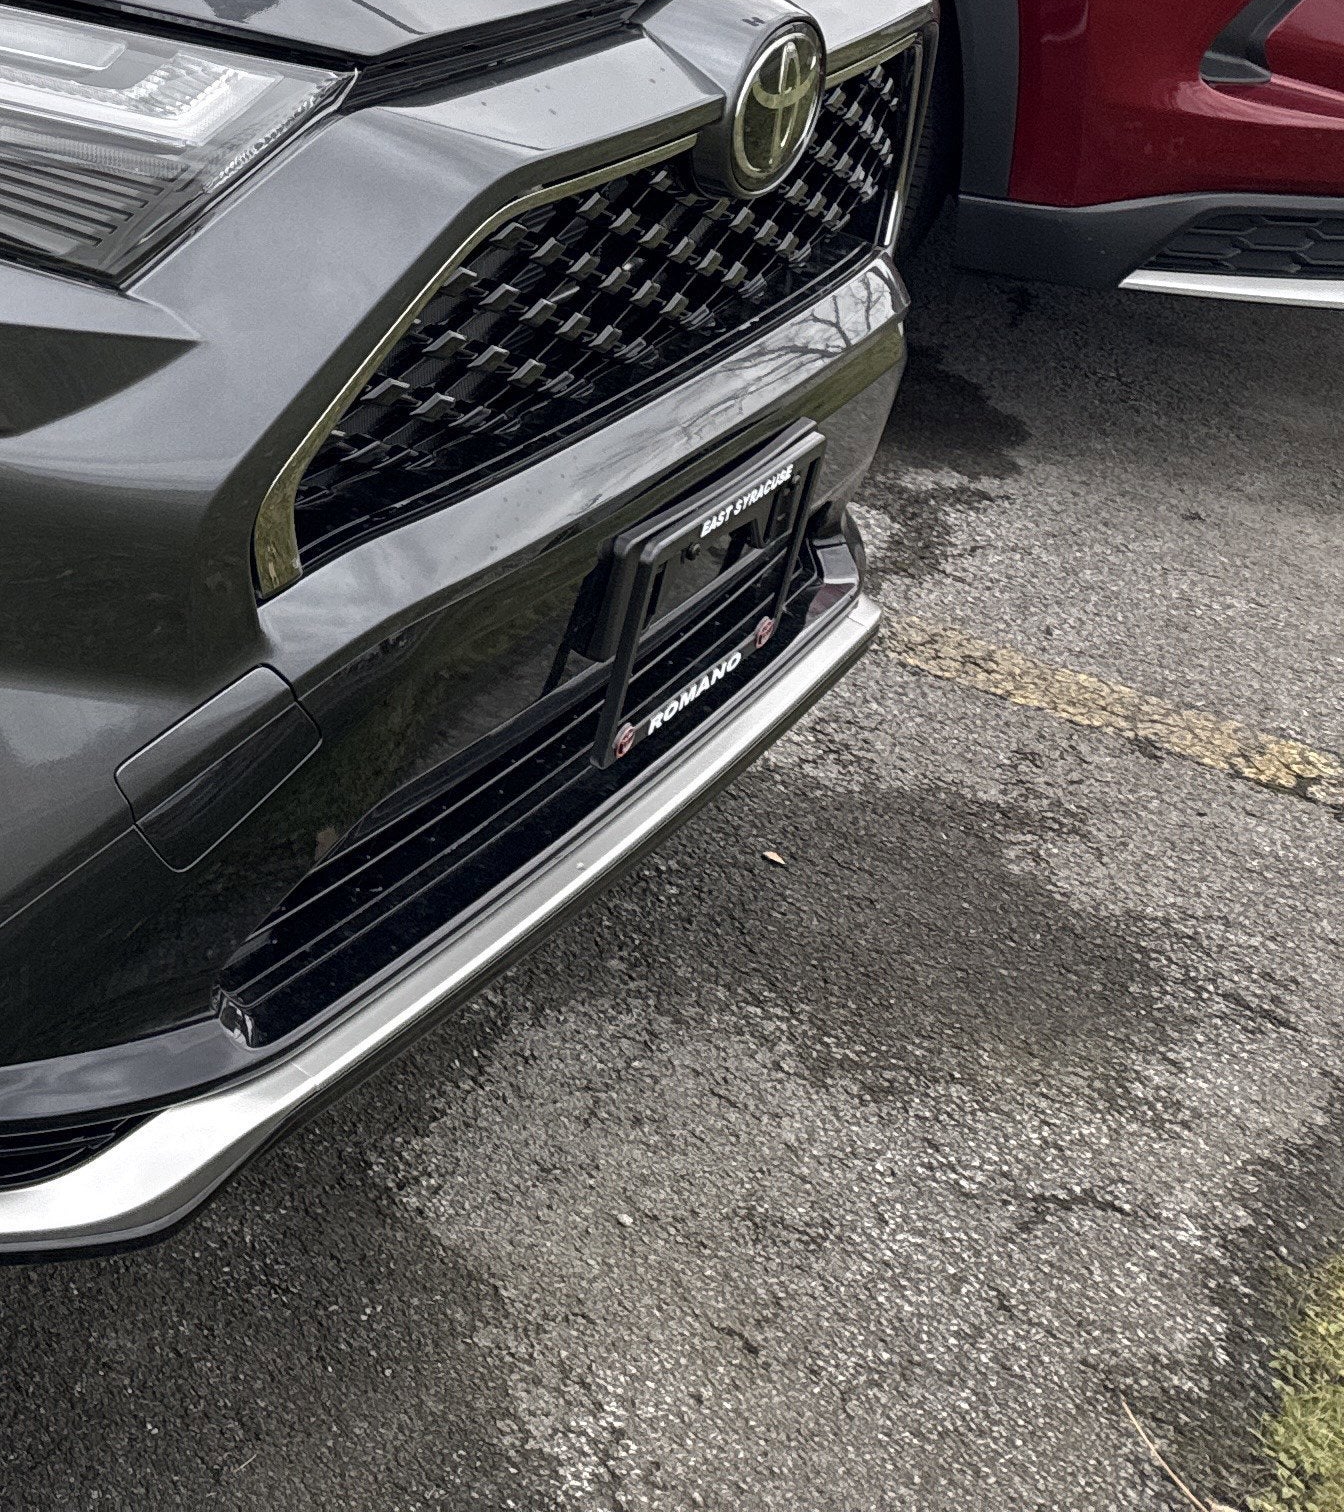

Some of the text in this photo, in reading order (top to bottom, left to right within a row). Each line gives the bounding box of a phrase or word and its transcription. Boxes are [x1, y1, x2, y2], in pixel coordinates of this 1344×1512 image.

[700, 463, 794, 538] EAST SYRACUSE
[647, 651, 743, 737] ROMANO
